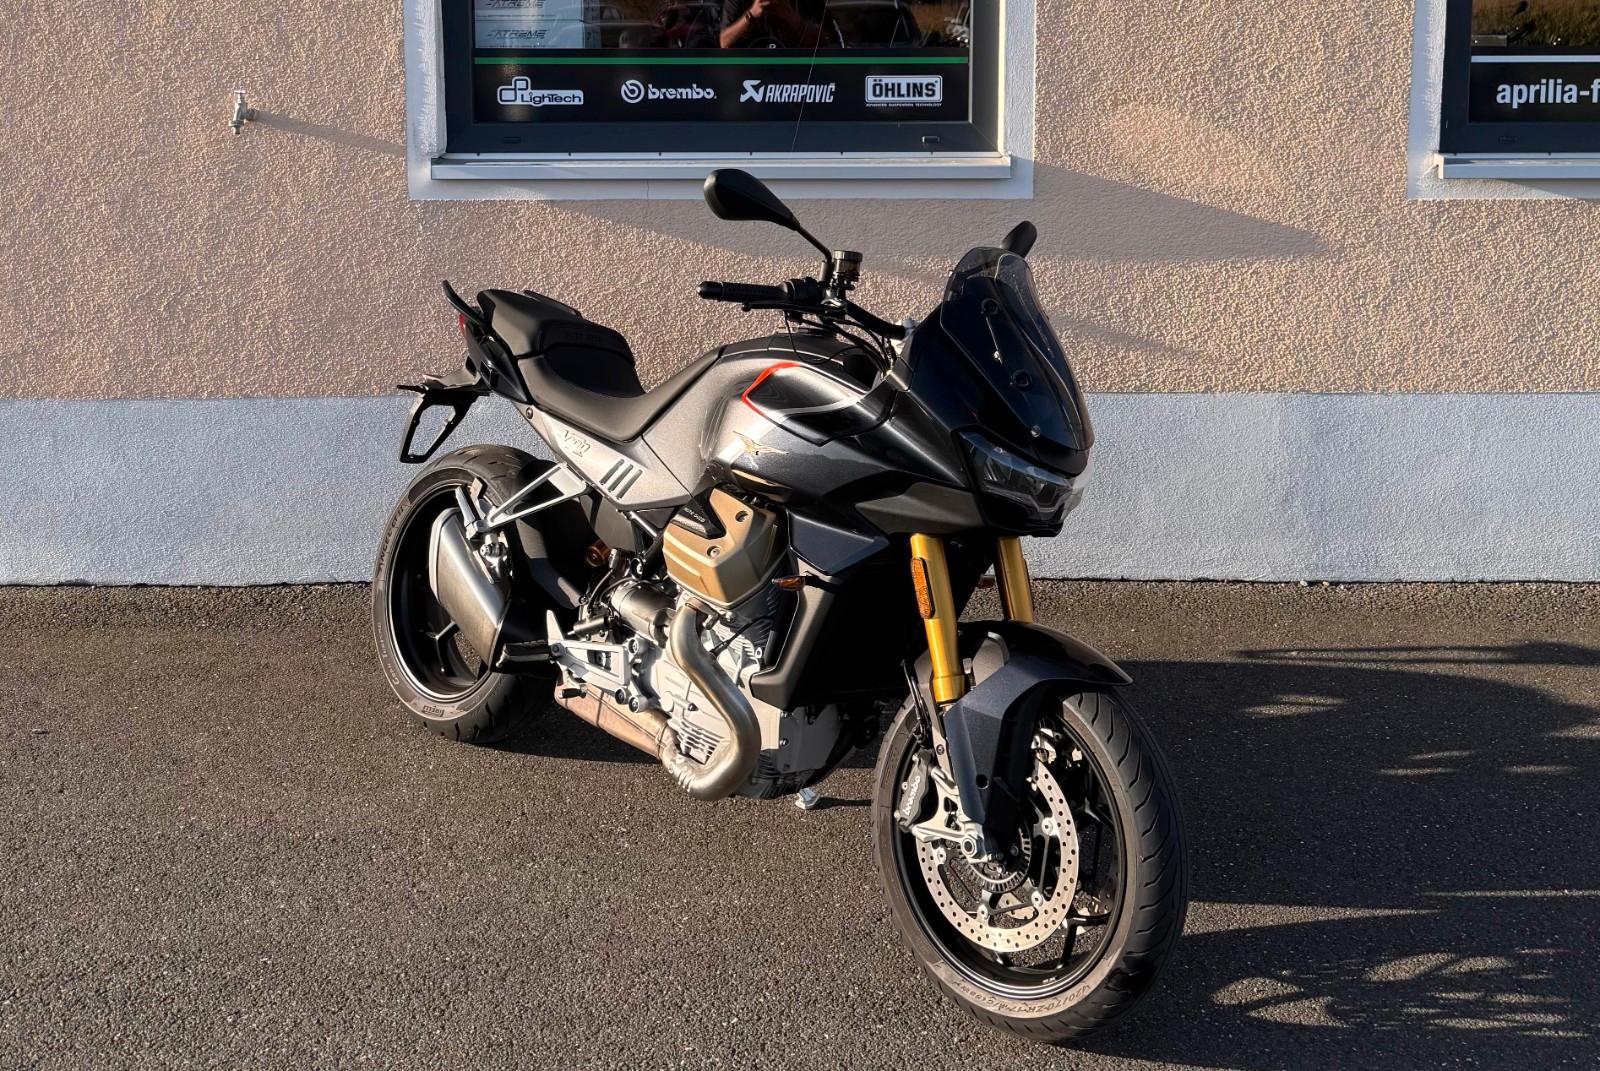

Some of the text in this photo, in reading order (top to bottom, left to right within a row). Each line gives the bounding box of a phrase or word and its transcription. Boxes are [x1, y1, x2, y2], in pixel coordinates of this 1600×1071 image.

[648, 83, 714, 100] brembo
[765, 82, 836, 103] AKRAPOVIČ
[872, 79, 936, 98] ÖHLINS
[903, 776, 920, 815] brembo
